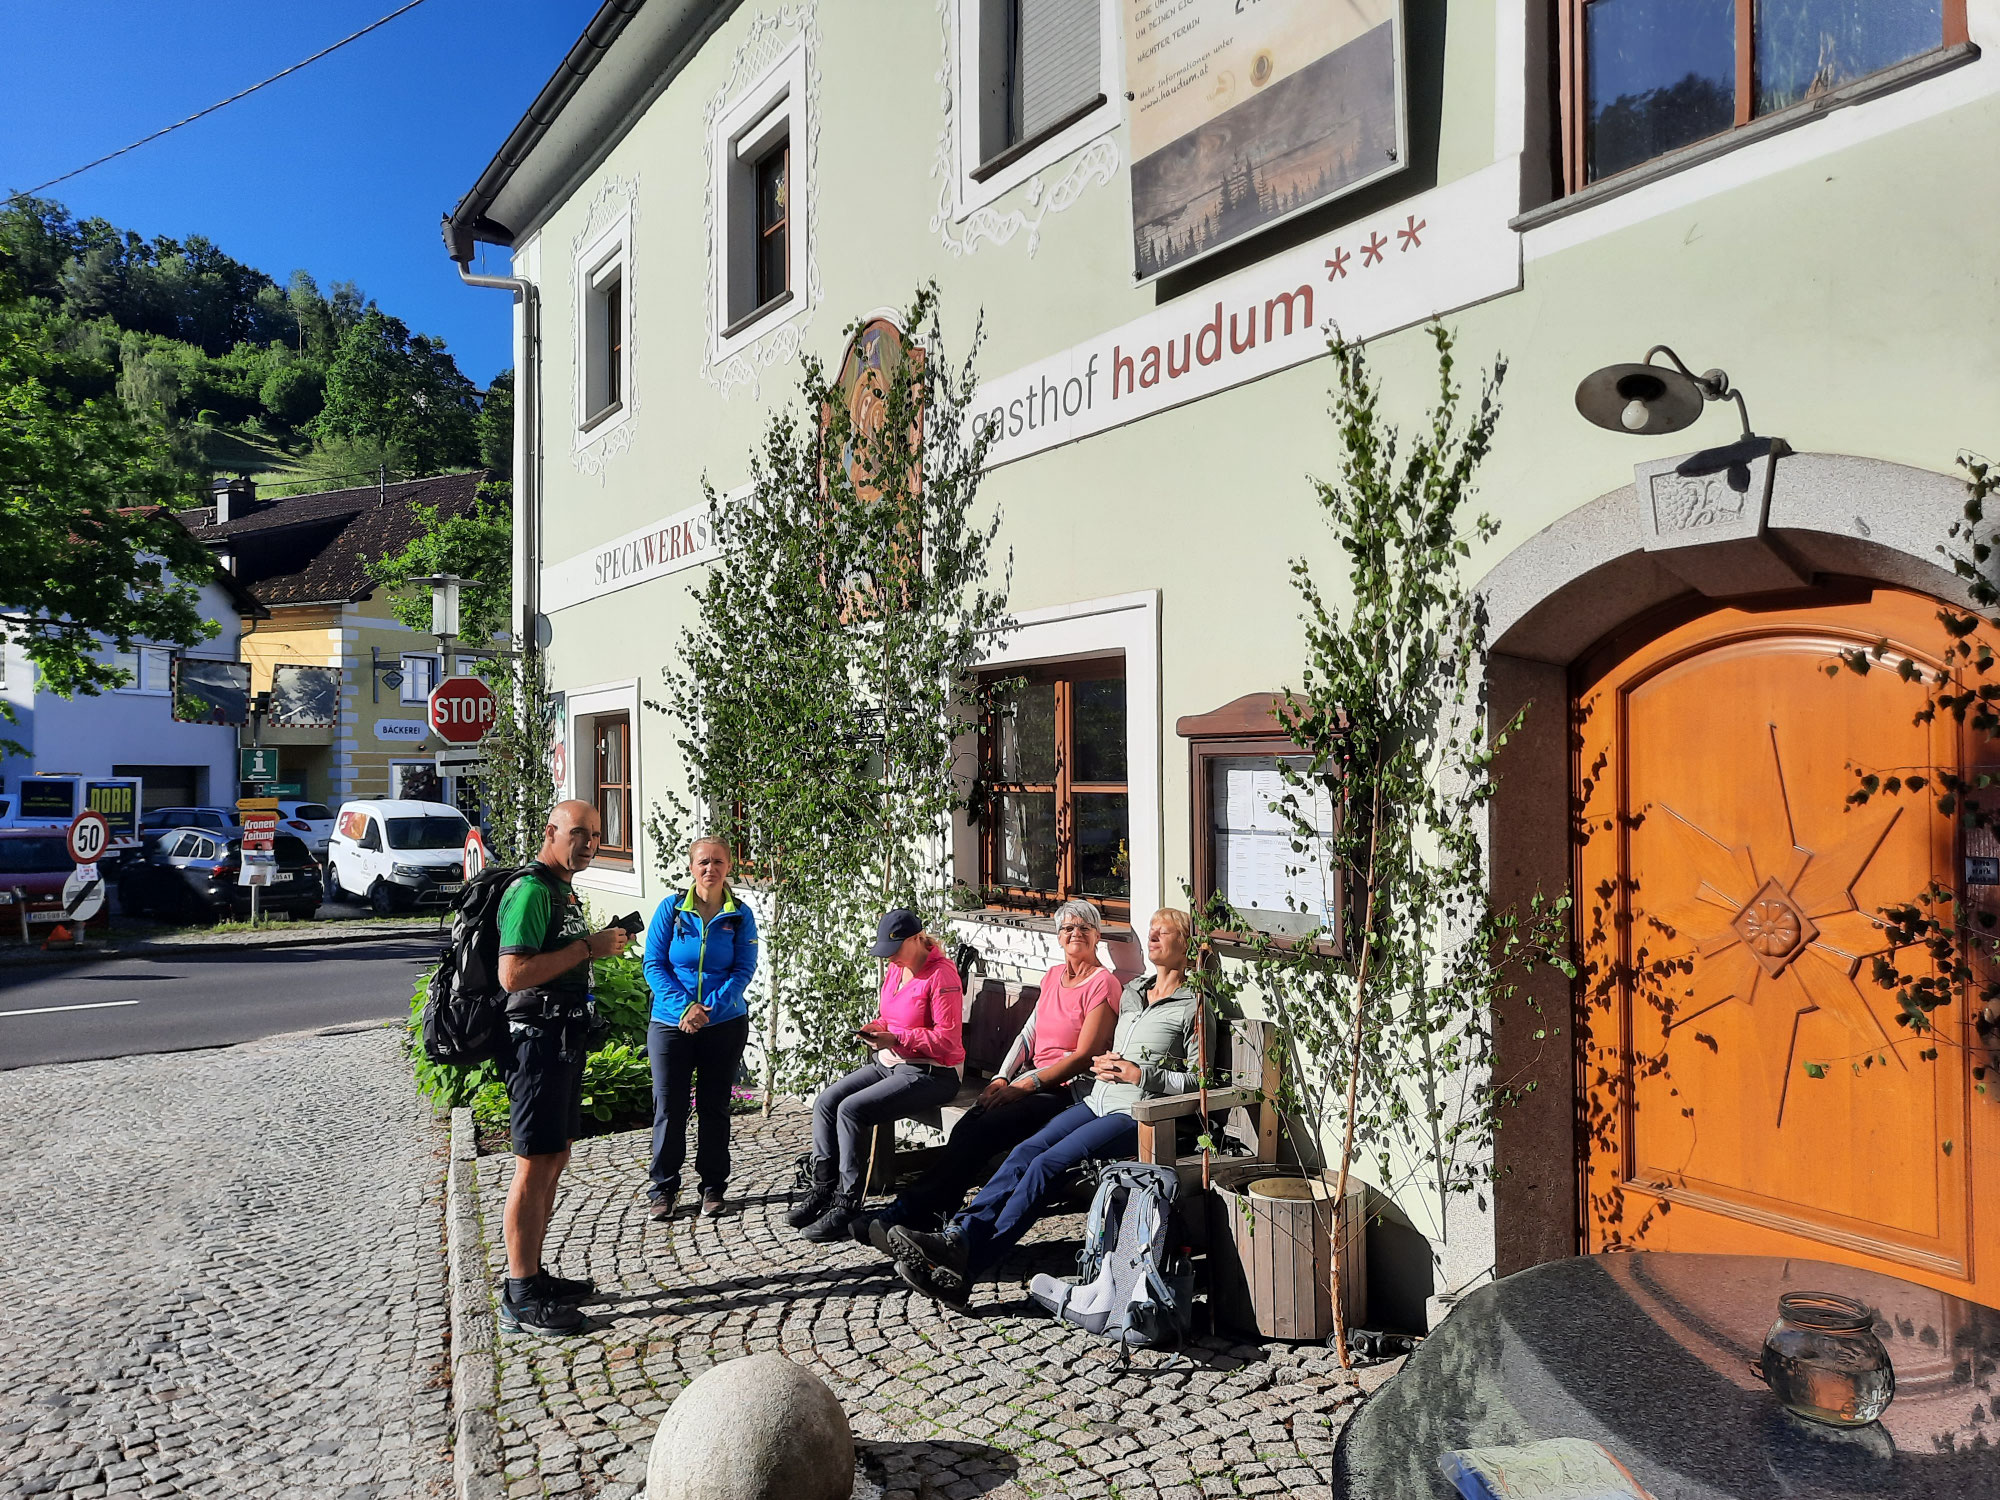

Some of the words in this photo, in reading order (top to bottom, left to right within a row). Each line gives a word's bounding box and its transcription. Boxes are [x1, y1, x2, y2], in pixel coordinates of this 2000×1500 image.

[971, 353, 1098, 460] gasthof
[1112, 284, 1314, 400] haudum
[435, 697, 492, 724] STOP
[382, 725, 421, 735] BÄCKEREI
[78, 825, 99, 852] 50
[243, 830, 275, 841] Zeitung
[244, 819, 275, 831] Kronen
[467, 847, 479, 880] 30
